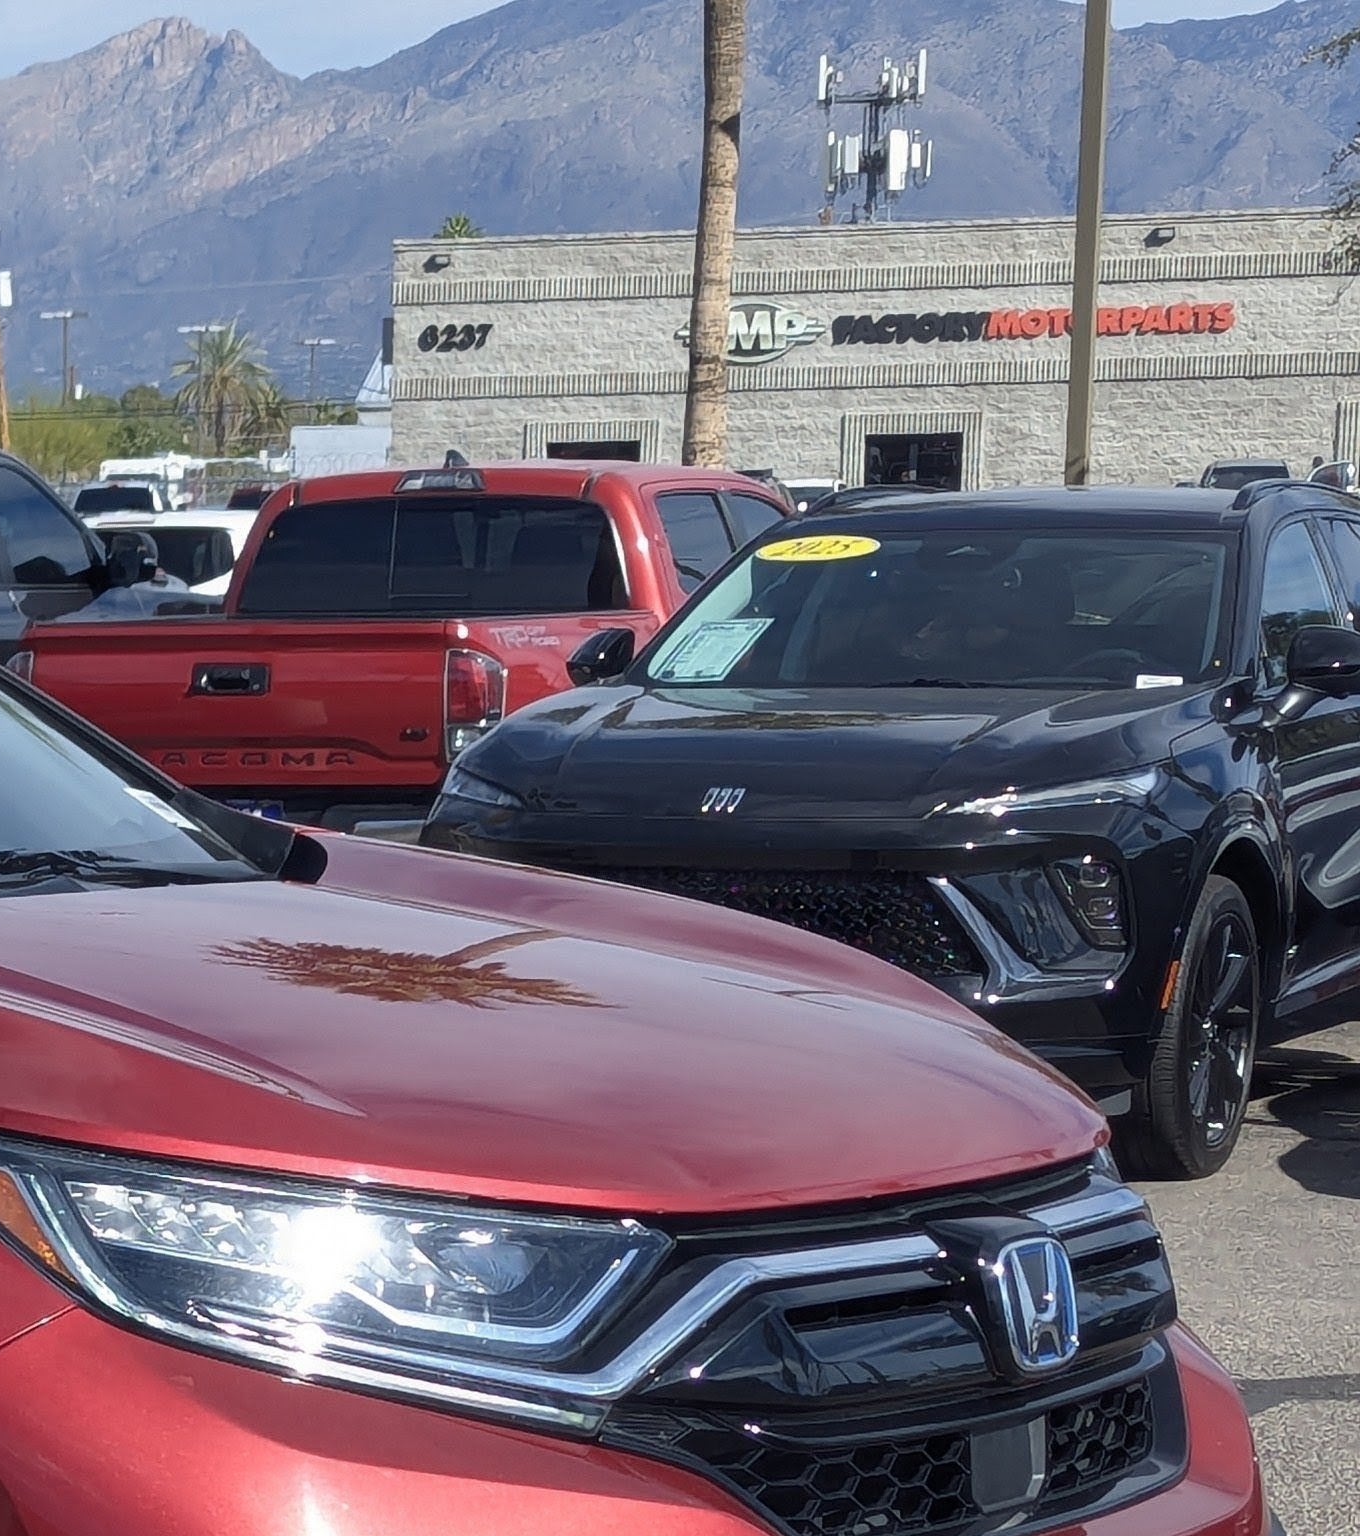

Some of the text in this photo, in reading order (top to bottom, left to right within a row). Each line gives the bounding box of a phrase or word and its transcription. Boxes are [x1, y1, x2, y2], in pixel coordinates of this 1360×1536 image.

[727, 310, 808, 351] MP
[983, 303, 1236, 340] MOTRPARTS
[160, 752, 355, 767] ACOMA
